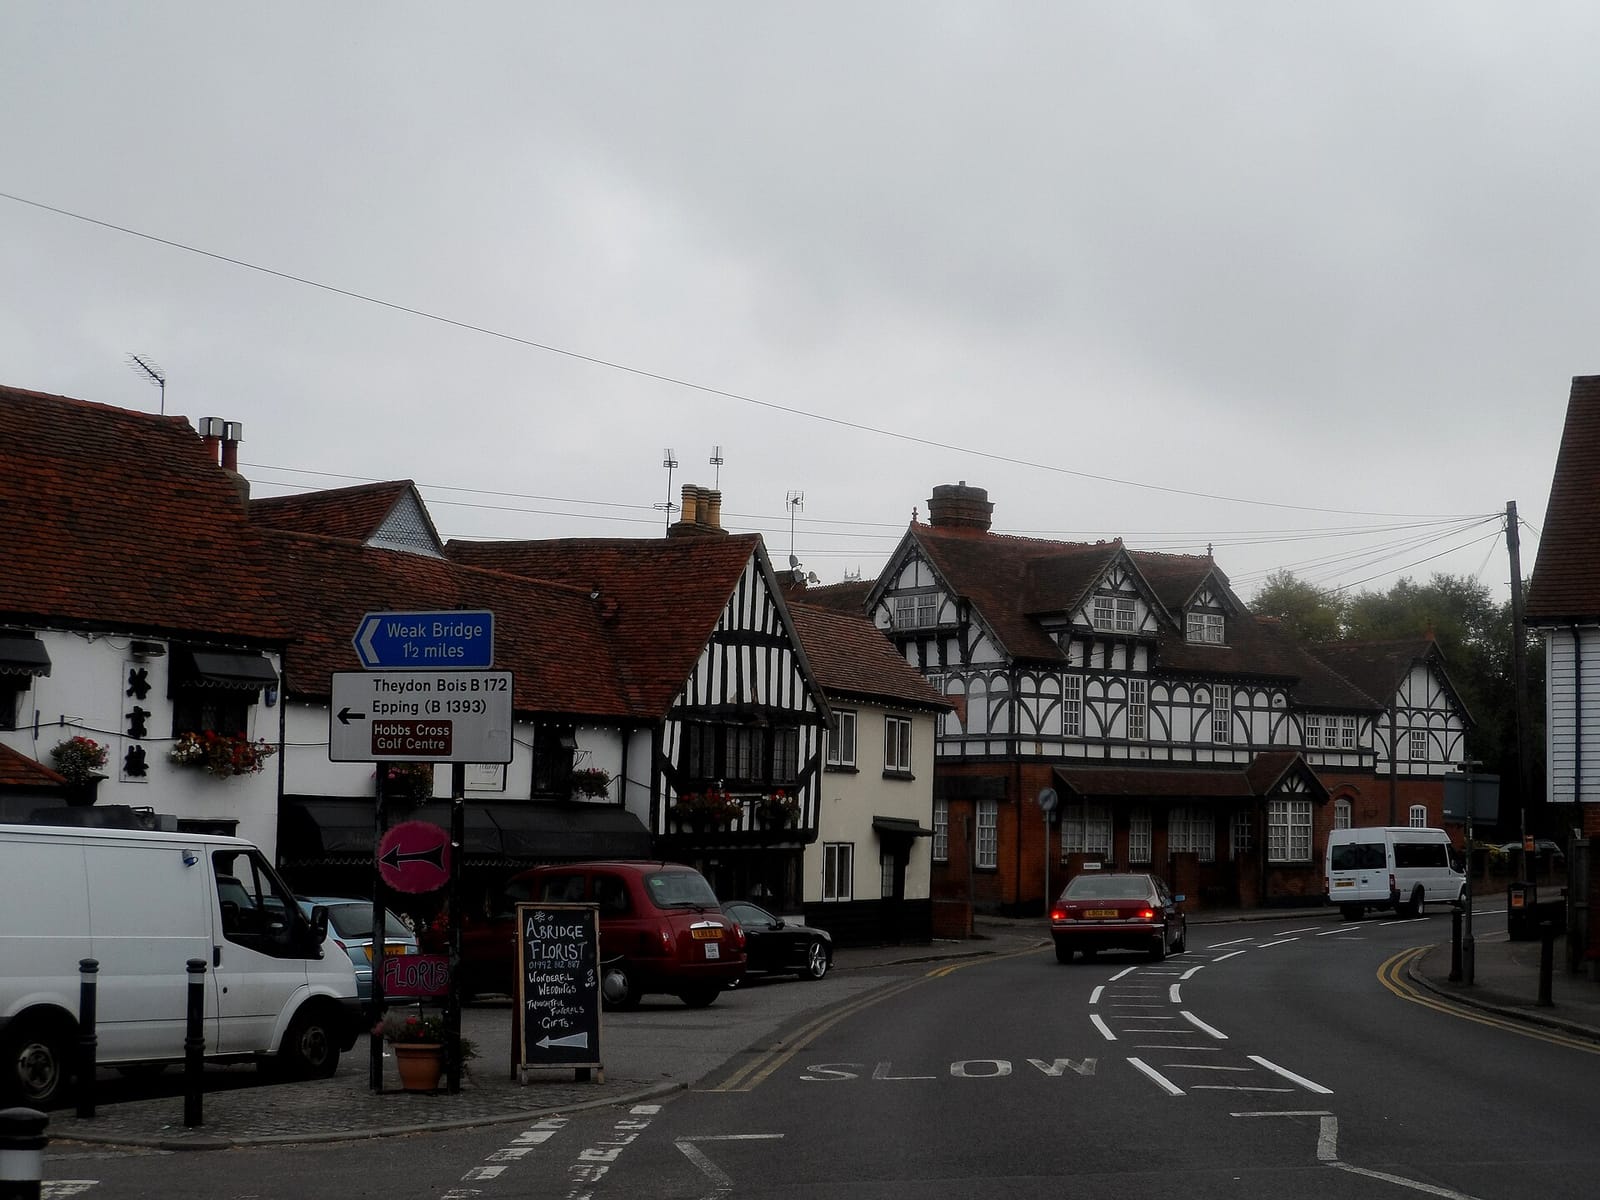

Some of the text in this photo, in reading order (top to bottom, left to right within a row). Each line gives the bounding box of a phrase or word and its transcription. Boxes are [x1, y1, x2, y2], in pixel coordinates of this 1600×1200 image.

[387, 622, 483, 639] Weak Bridge
[424, 643, 464, 657] miles
[373, 679, 431, 694] Theydon
[437, 679, 467, 691] Bois
[373, 700, 419, 715] Epping
[446, 700, 487, 714] 1393)
[374, 724, 450, 736] Hobbs Cross
[377, 737, 445, 749] Golf Centre
[526, 917, 584, 940] ABRIDGE
[528, 939, 588, 962] FLORIST
[384, 958, 449, 992] FLORIS
[799, 1058, 1098, 1081] SLOW
